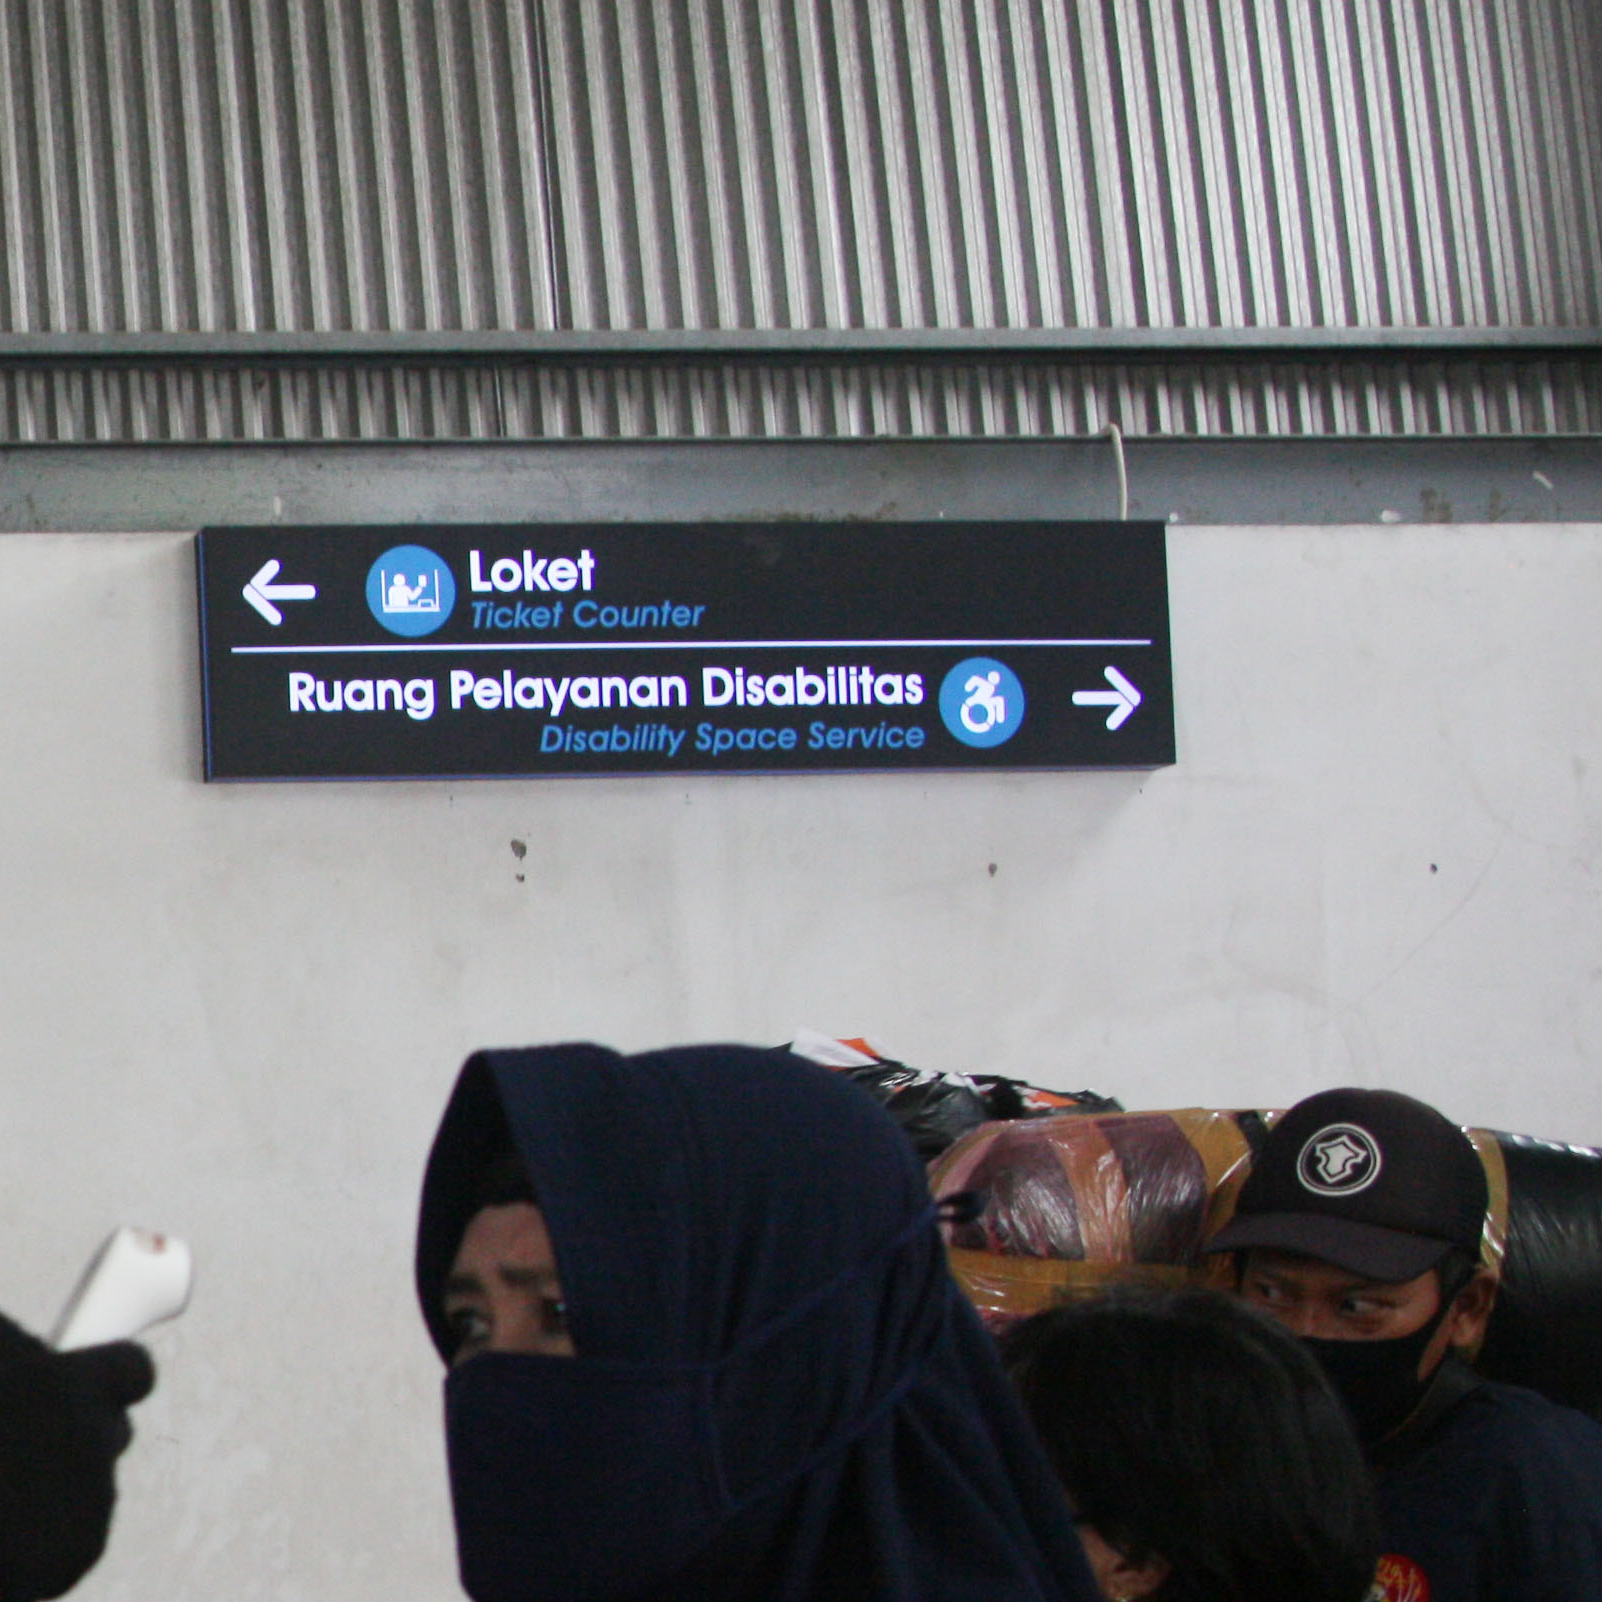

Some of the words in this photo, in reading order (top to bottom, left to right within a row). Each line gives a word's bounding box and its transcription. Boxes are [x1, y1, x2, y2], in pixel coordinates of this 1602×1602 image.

[469, 549, 596, 592] Loket
[472, 600, 563, 630] Ticket
[573, 599, 705, 628] Counter
[288, 671, 435, 721] Ruang
[450, 669, 688, 717] Pelayanan
[701, 665, 925, 707] Disabilitas
[539, 723, 687, 757] Disability
[695, 722, 797, 756] Space
[807, 721, 926, 751] Service
